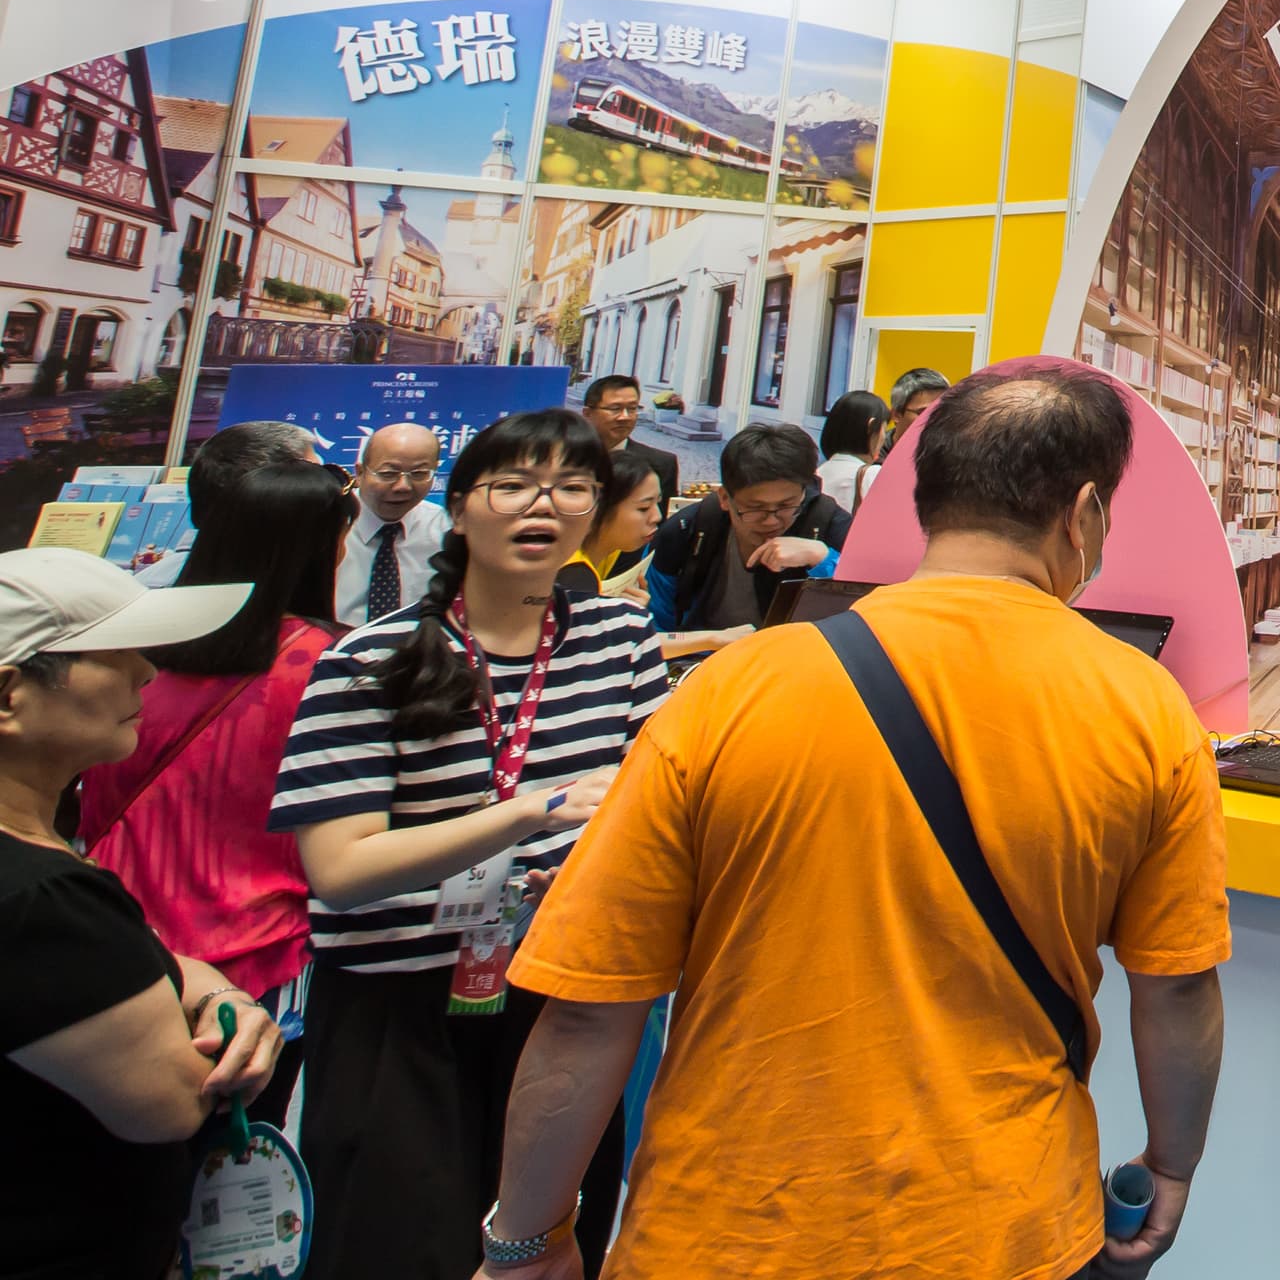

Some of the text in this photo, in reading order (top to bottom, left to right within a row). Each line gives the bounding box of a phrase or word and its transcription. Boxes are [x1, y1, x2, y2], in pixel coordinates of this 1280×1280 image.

[335, 11, 518, 103] 德瑞
[566, 18, 749, 72] 浪漫雙峰
